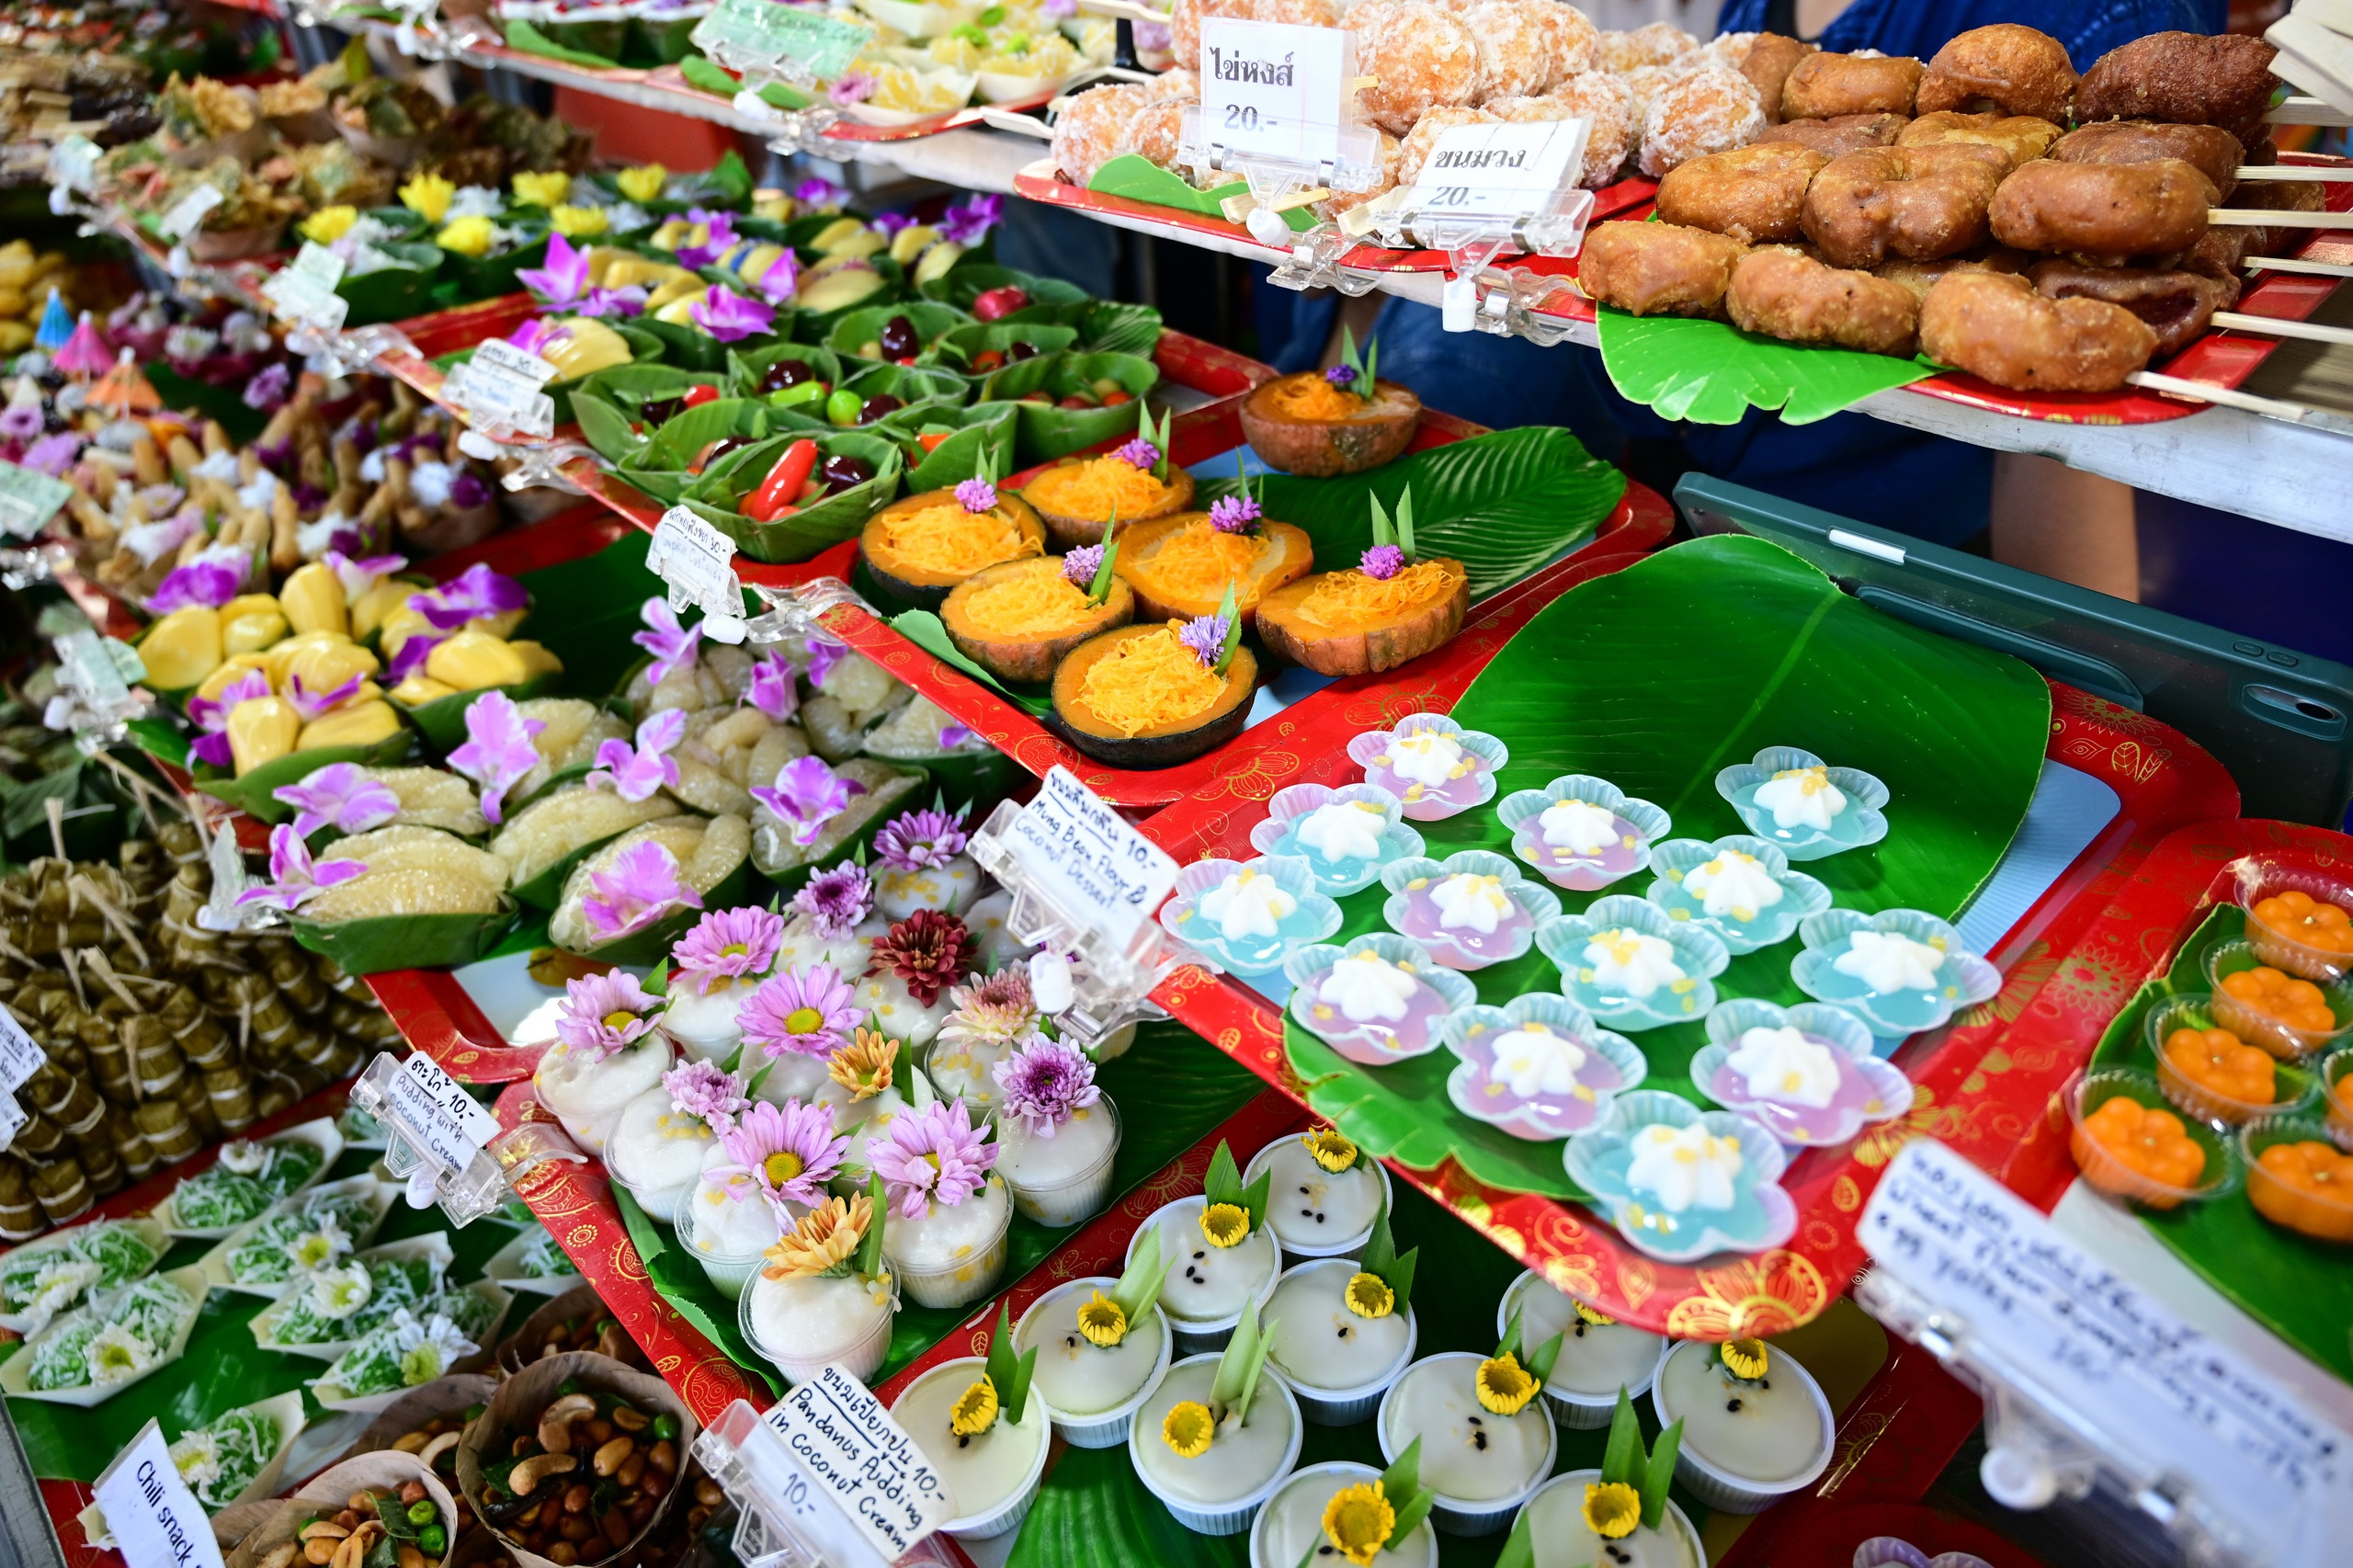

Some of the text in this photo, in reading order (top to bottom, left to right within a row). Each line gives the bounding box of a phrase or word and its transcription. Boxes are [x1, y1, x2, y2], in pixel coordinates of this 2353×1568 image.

[1209, 46, 1295, 87] ไข่หงส์
[1223, 103, 1278, 132] 20.-
[1434, 147, 1526, 170] ขนมวง
[1427, 186, 1486, 206] 20.-
[411, 1060, 475, 1119] ตะโก้ 10.-
[790, 1387, 923, 1531] Pandanus Pudding
[824, 1367, 945, 1501] ขนมเปียกปูน 10.-
[769, 1407, 908, 1552] in Coconut Cream
[783, 1472, 815, 1515] 10.-
[137, 1460, 195, 1568] Chili snack
